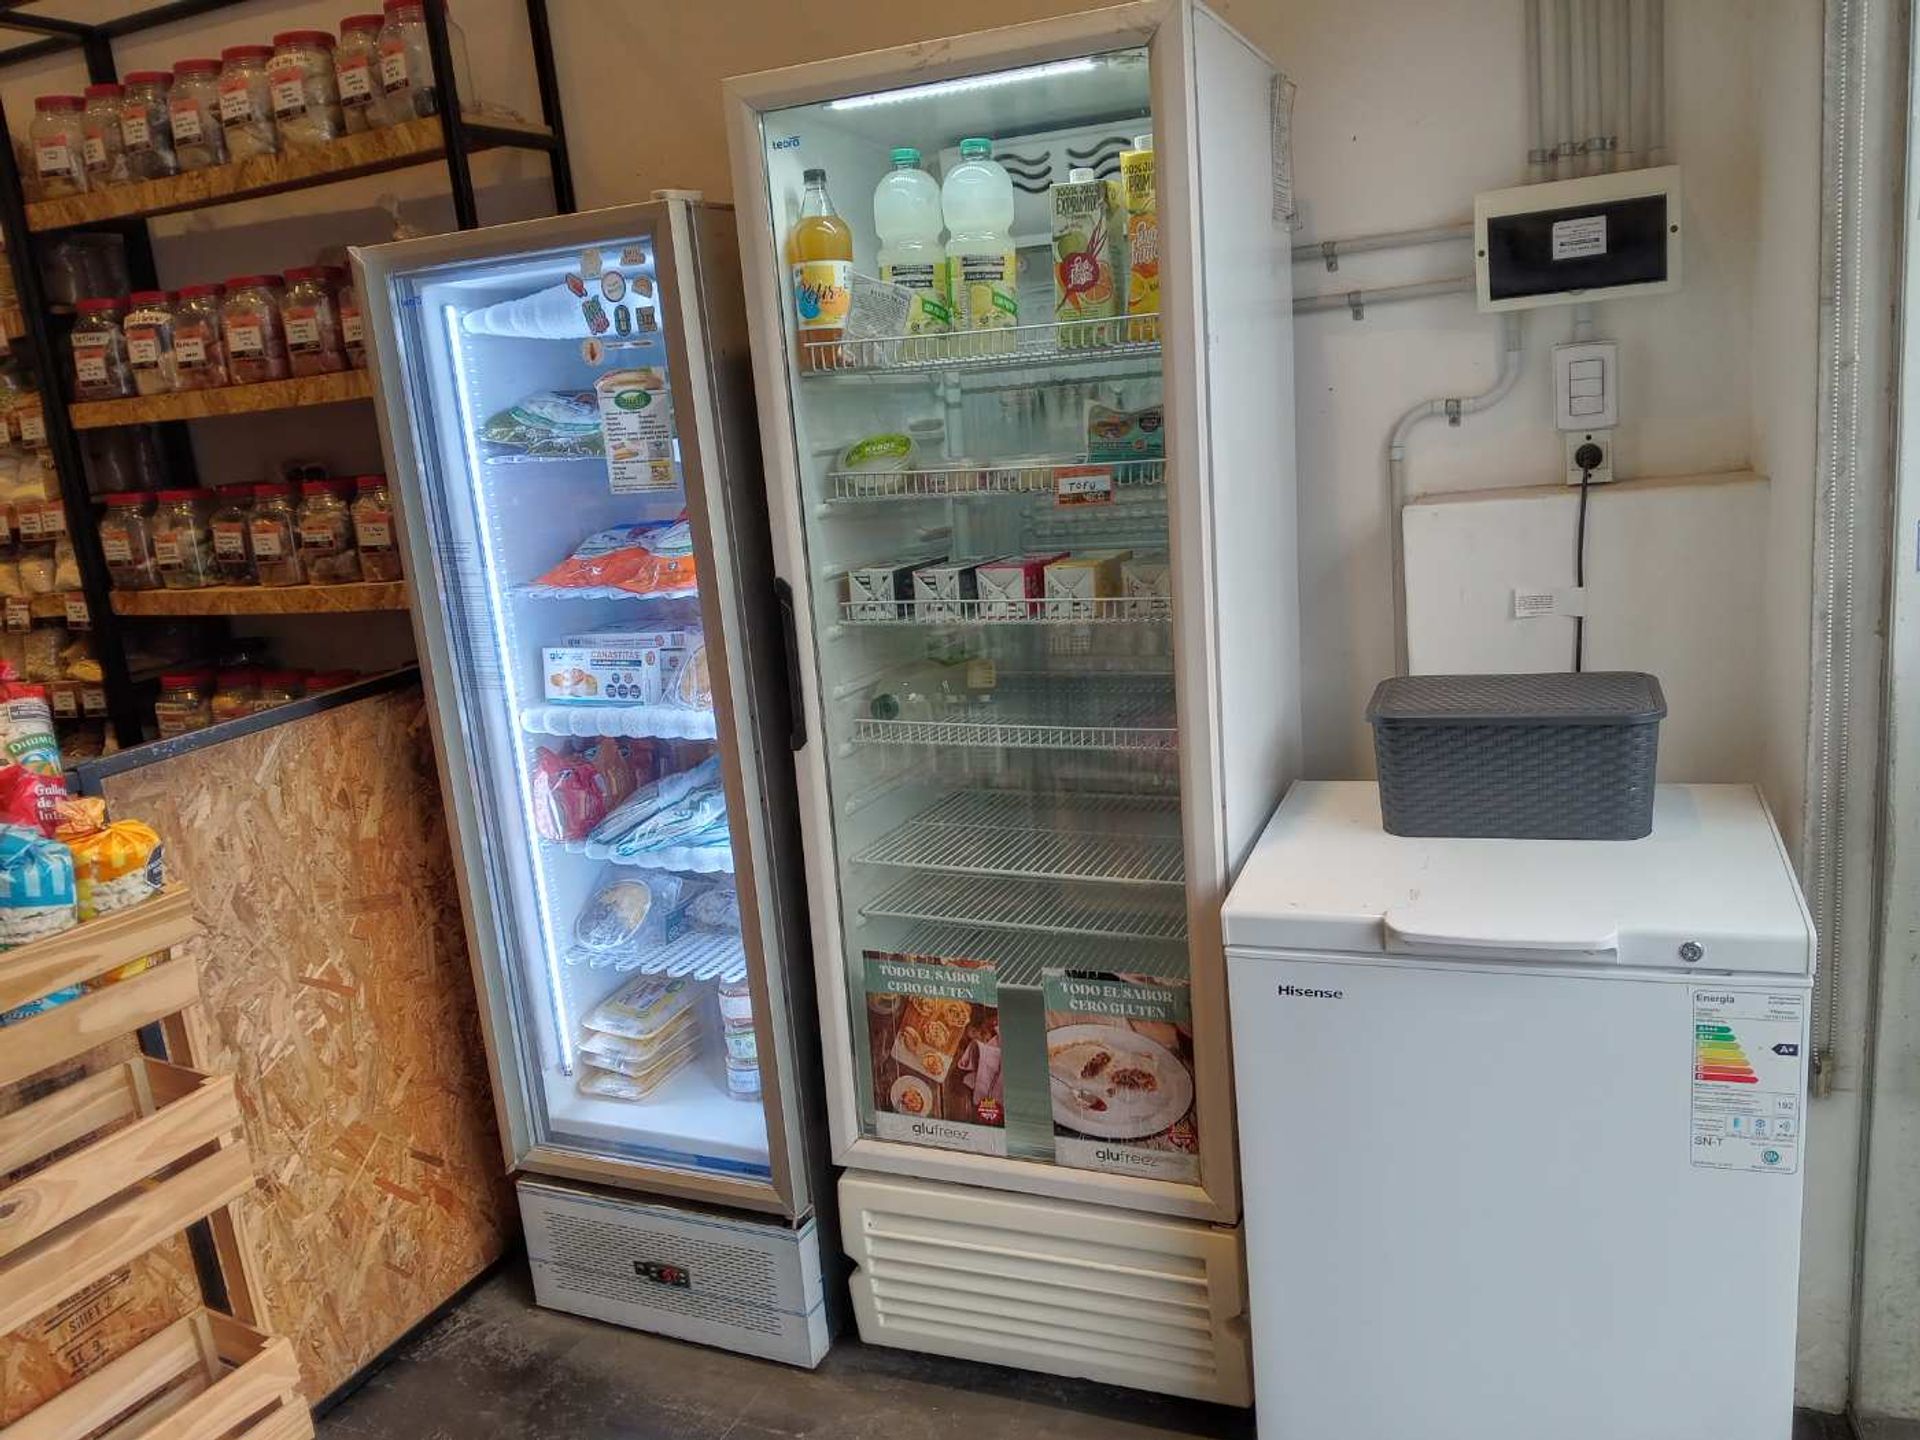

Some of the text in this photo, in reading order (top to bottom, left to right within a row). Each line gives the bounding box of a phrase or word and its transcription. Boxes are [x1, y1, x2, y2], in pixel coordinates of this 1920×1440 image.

[879, 964, 981, 985] TODO EL SABOR
[887, 981, 974, 999] CERO GLUTEN
[1060, 982, 1173, 1003] TODO EL SABOR
[1278, 984, 1344, 999] Hisense
[1069, 999, 1166, 1018] CERO GLUTEN
[912, 1122, 969, 1140] glufreez
[1096, 1148, 1160, 1167] glufreez
